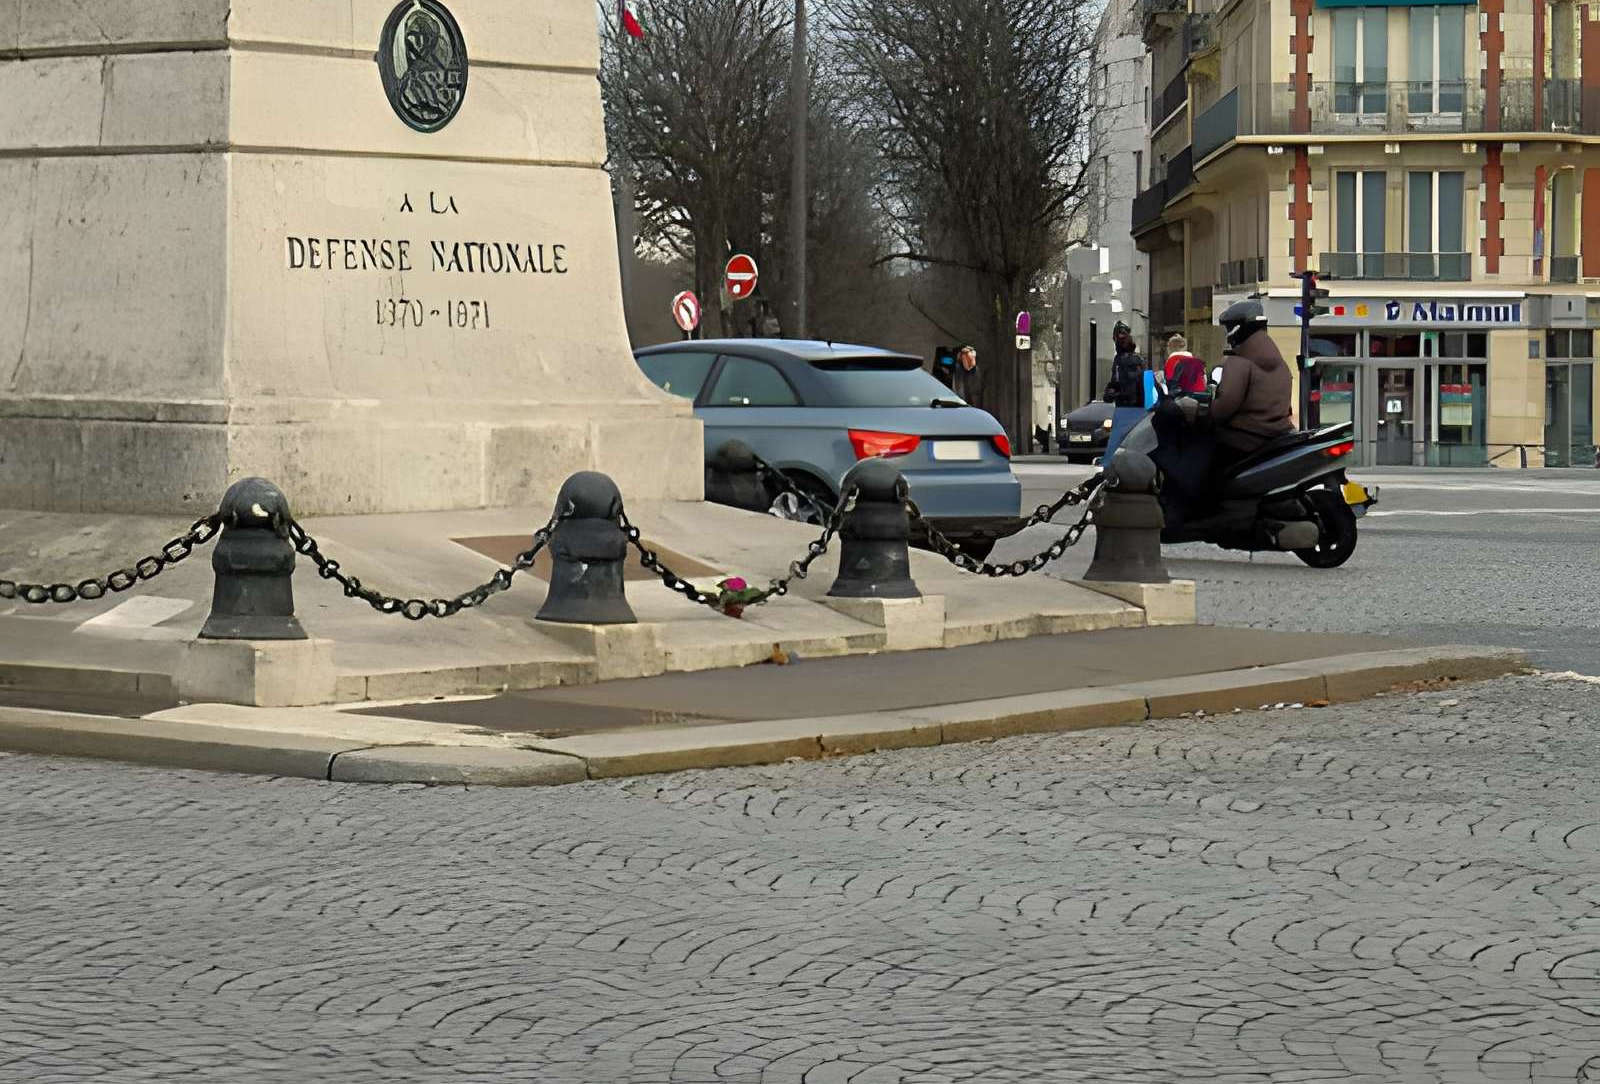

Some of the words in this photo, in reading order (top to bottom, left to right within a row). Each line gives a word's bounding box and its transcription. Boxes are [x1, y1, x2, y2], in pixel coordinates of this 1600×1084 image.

[400, 193, 414, 213] A
[429, 191, 459, 214] LA
[286, 236, 412, 271] DEFENSE
[430, 240, 568, 274] NATIONALE
